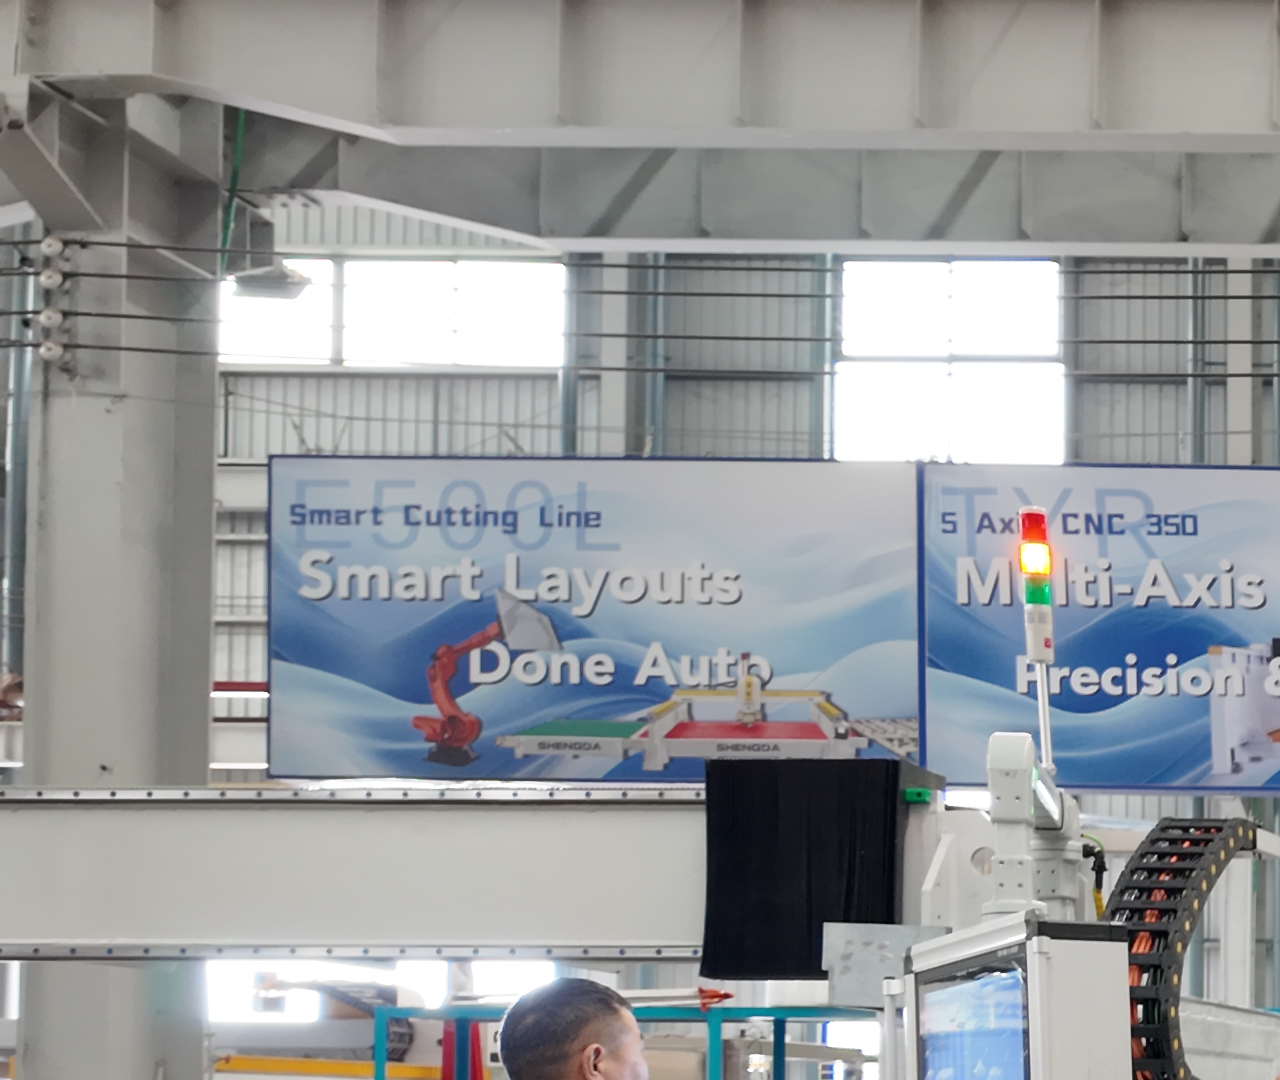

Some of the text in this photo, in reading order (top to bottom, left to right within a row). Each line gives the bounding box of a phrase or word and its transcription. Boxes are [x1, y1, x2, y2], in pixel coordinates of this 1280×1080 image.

[289, 504, 602, 534] Smart Cutting Line
[296, 480, 621, 551] E500L
[976, 512, 1021, 535] Axi
[1062, 513, 1126, 535] CNC
[1146, 514, 1199, 536] 350
[298, 549, 743, 618] Smart Layouts
[956, 556, 1267, 608] Mlti-Axis
[469, 640, 773, 688] Done Auto
[1016, 652, 1246, 697] Precision
